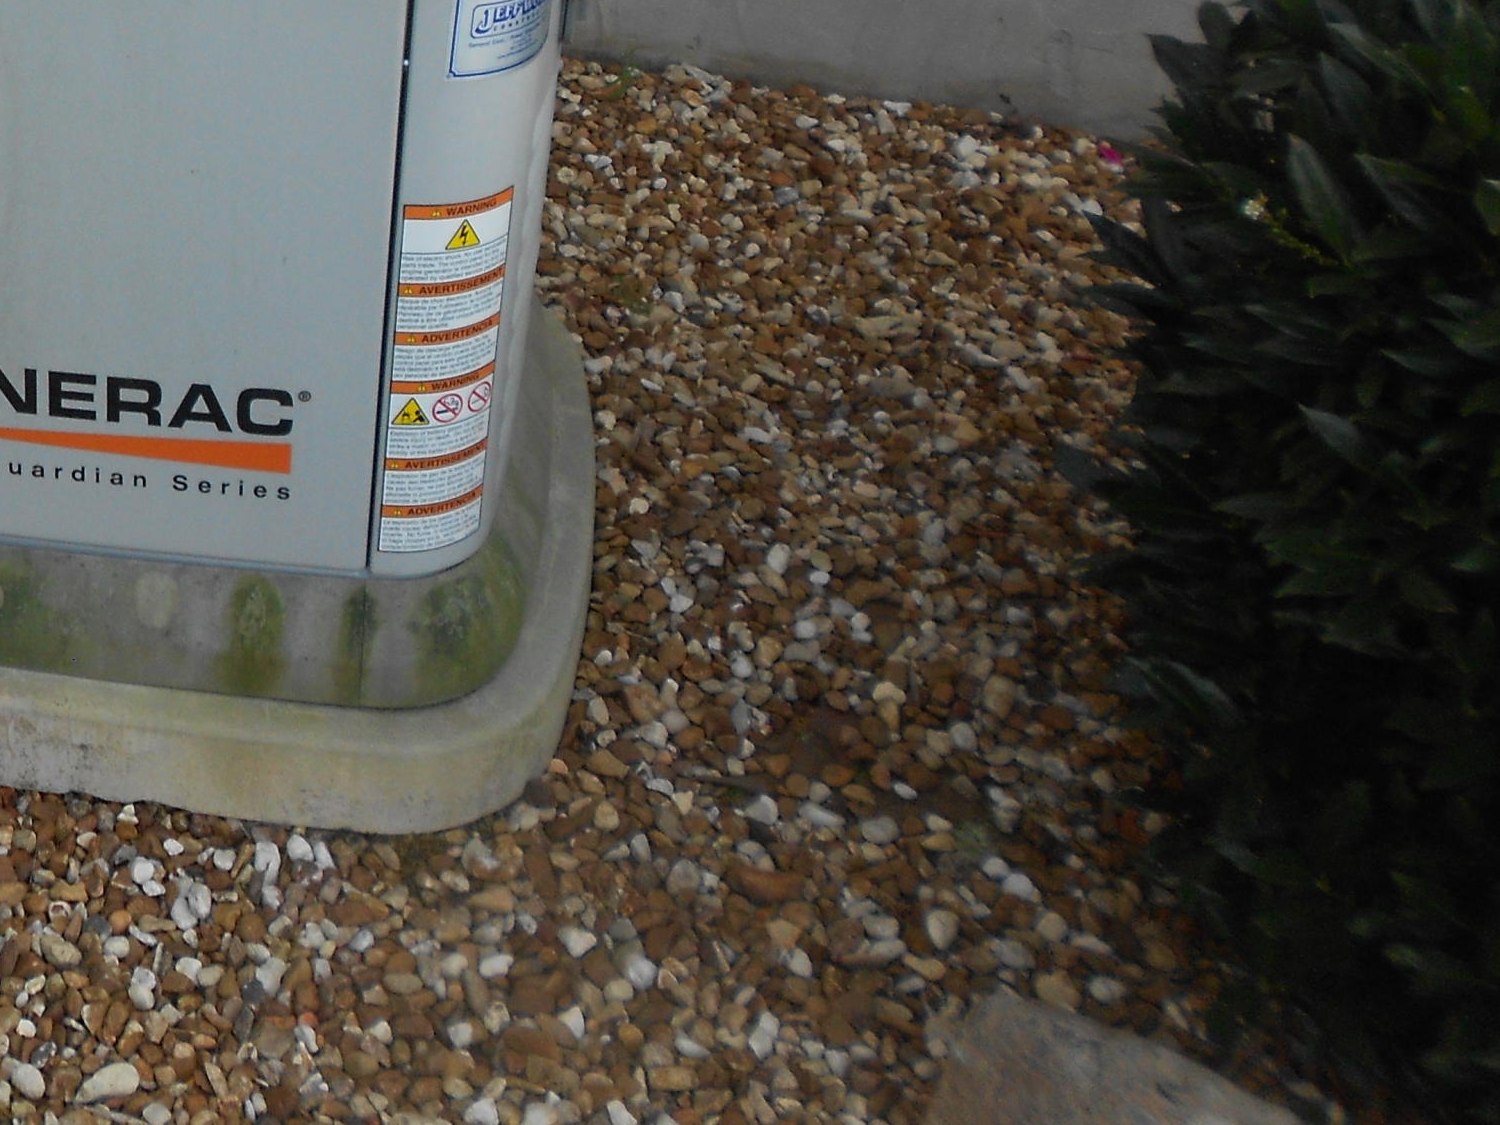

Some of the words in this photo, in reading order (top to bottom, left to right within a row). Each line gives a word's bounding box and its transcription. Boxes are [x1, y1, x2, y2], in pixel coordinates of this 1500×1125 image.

[446, 198, 497, 216] WARNING
[419, 267, 503, 295] AVERTISSEMENT
[421, 319, 493, 344] ADVERTENCIA
[431, 372, 480, 391] WARNING
[405, 441, 486, 469] AVERTISSEMENT
[172, 474, 291, 500] Series
[407, 491, 477, 516] ADVERTENCIA
